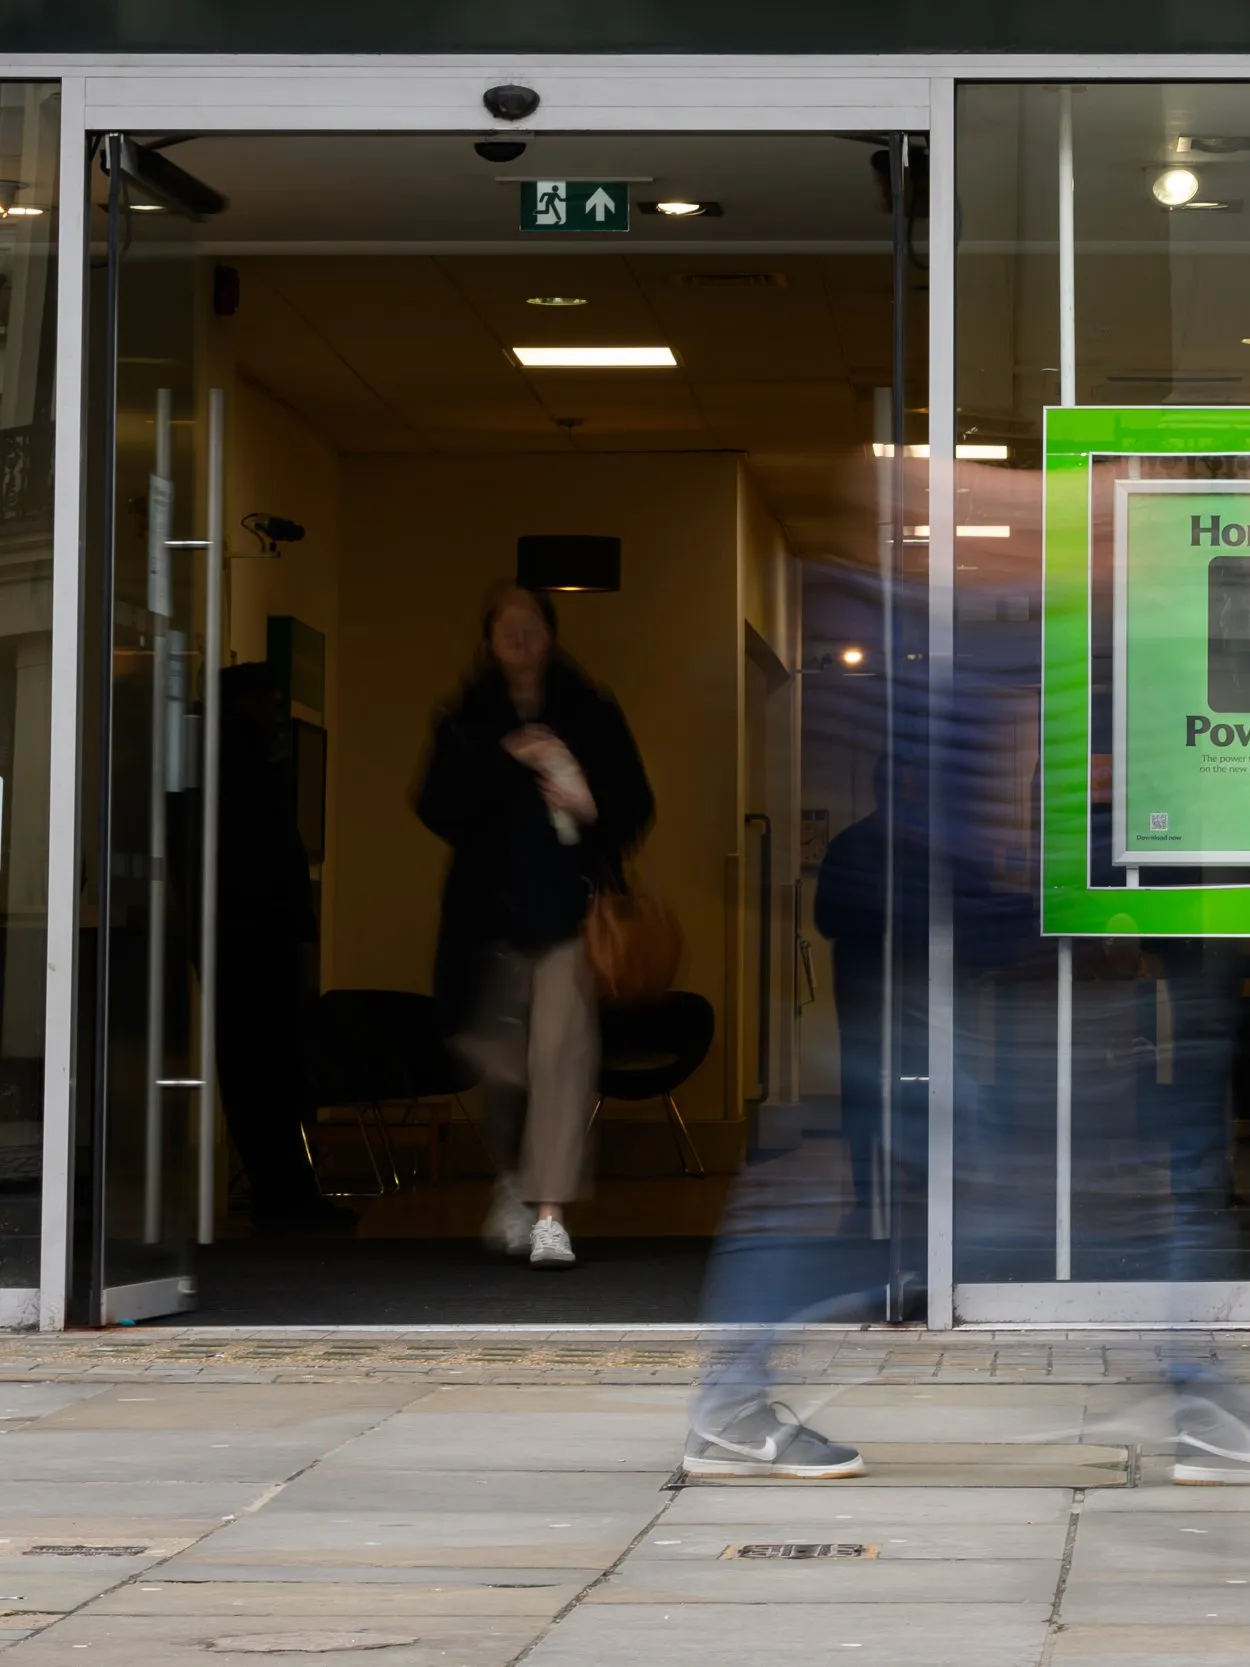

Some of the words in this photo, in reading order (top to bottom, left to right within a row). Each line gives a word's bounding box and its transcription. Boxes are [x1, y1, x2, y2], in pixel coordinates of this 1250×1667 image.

[1202, 754, 1218, 763] The
[1219, 755, 1247, 764] power
[1200, 766, 1211, 774] on
[1213, 765, 1227, 774] the
[1229, 766, 1248, 774] new
